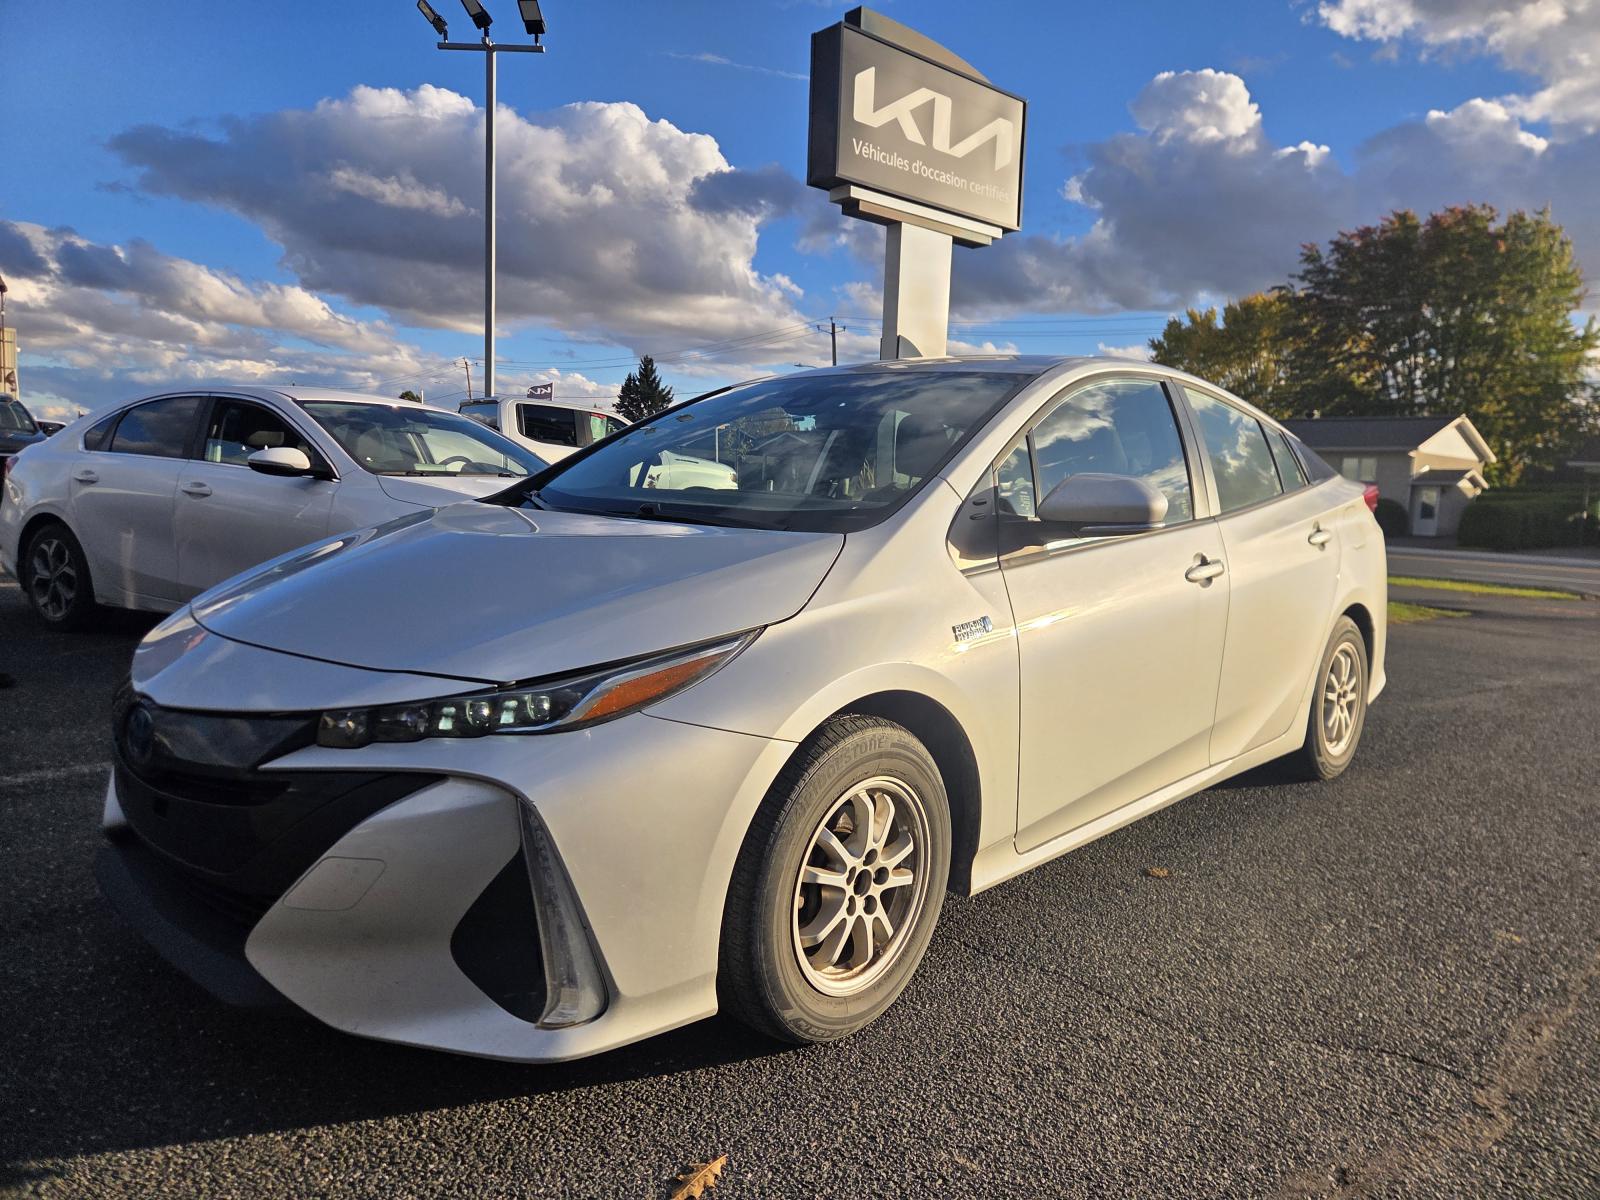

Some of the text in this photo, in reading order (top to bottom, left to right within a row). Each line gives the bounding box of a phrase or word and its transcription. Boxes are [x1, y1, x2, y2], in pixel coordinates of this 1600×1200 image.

[853, 66, 1014, 171] KIA
[852, 137, 910, 171] Véhicules
[911, 160, 968, 190] d'occasion
